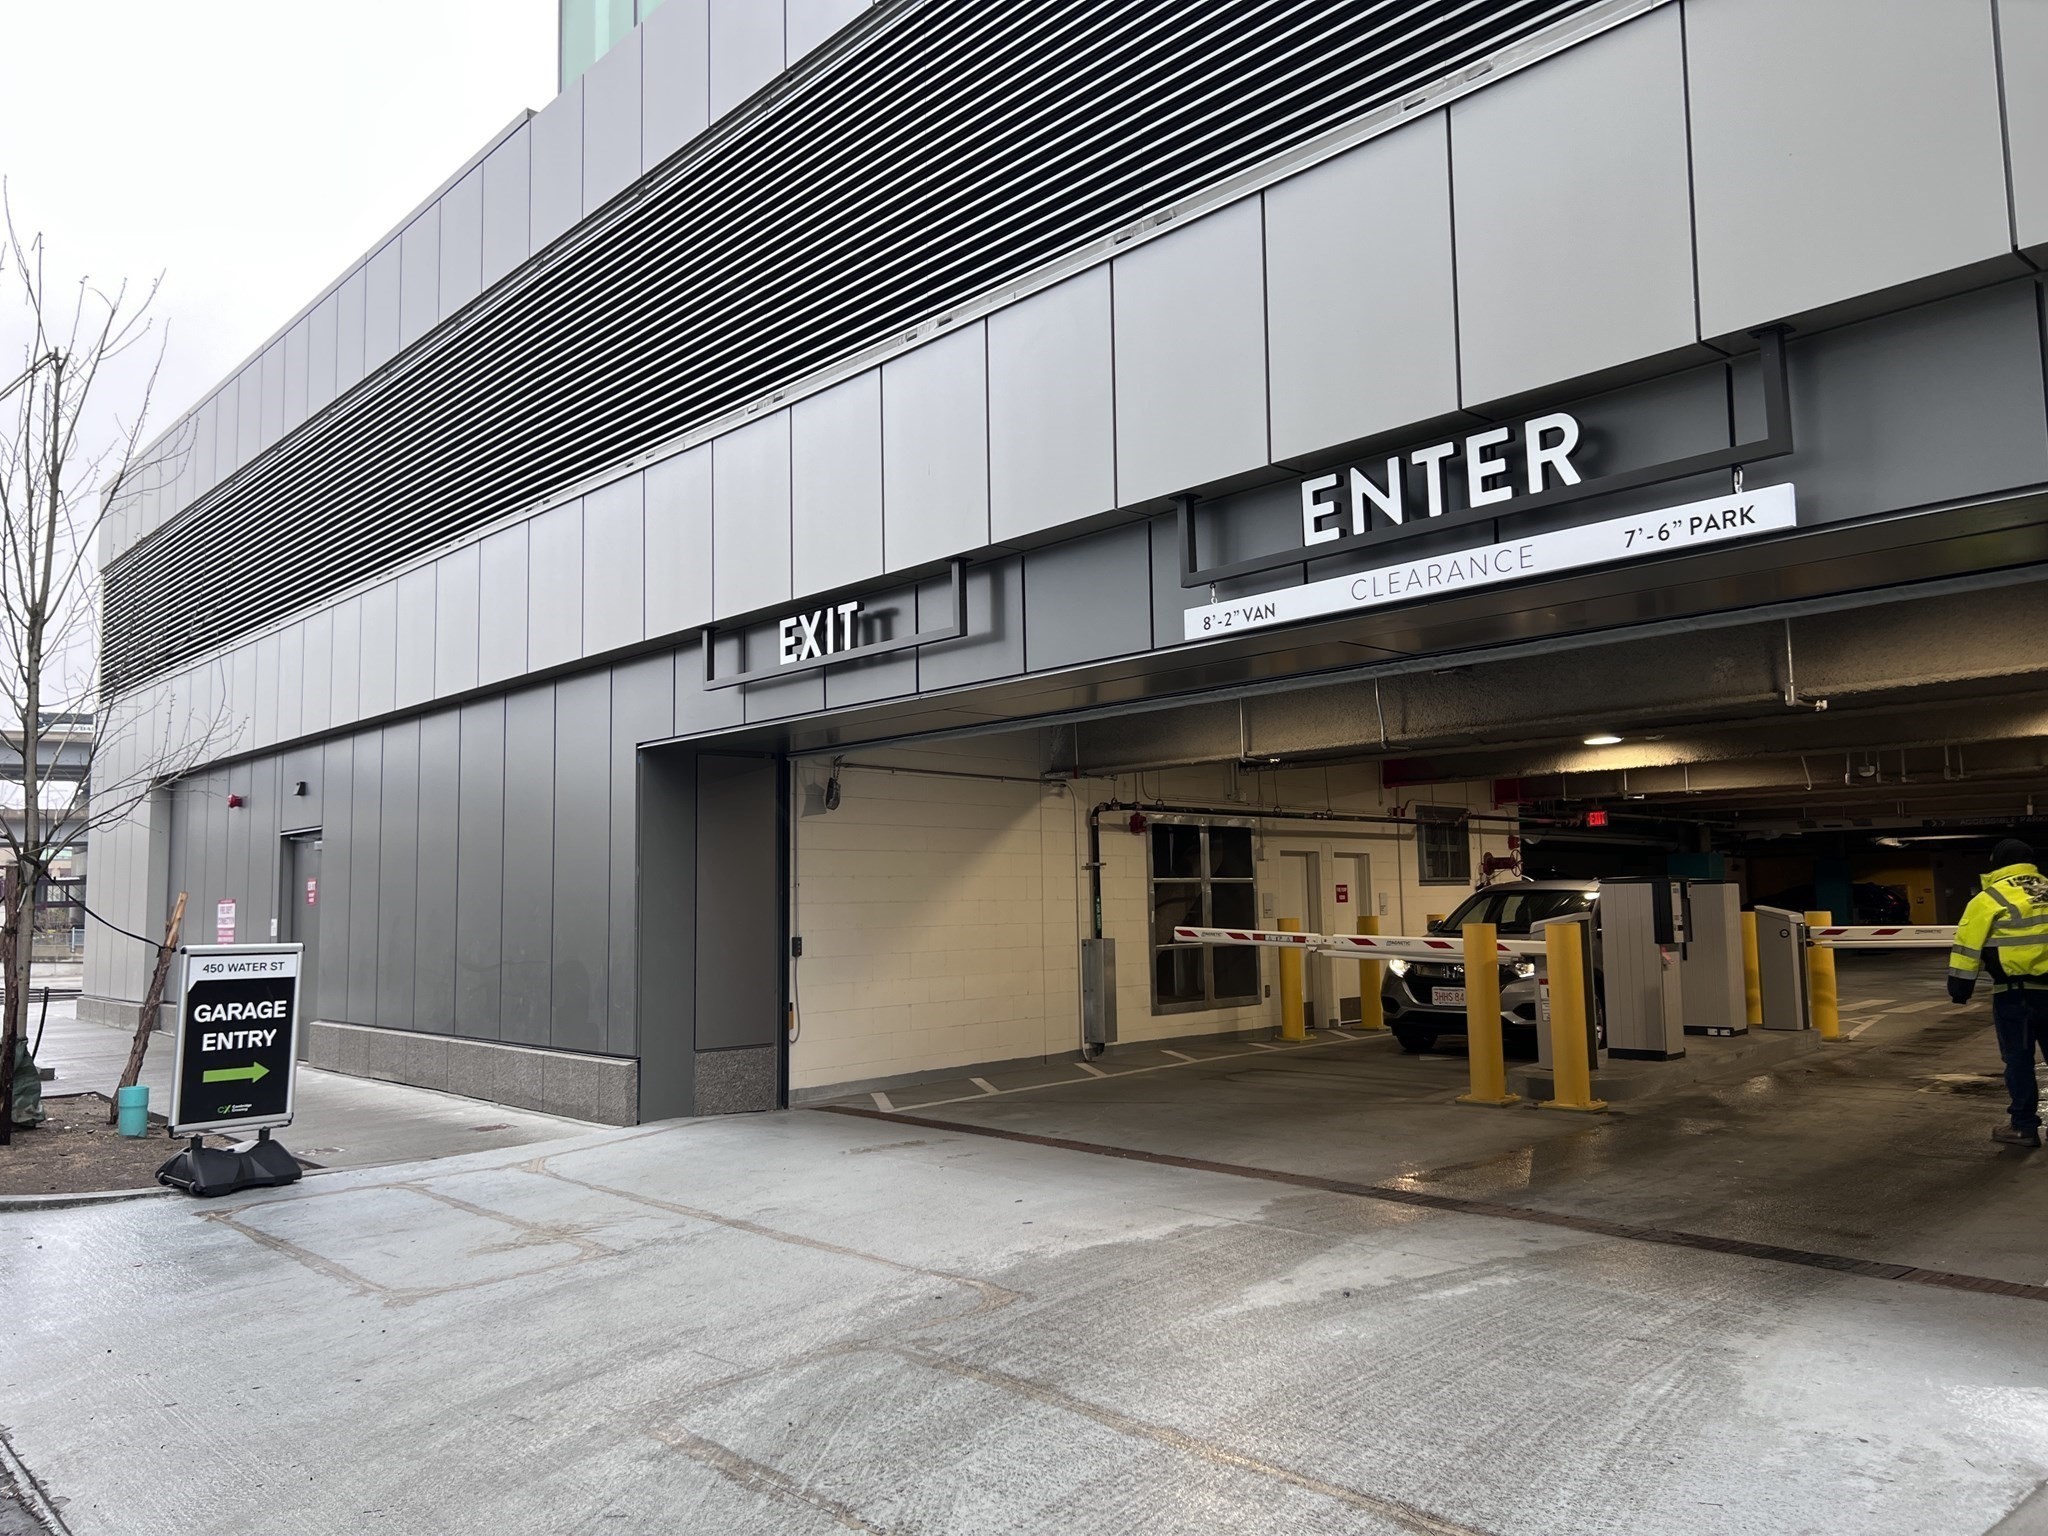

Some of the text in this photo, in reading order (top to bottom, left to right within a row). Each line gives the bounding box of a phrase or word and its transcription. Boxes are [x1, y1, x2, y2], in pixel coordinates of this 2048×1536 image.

[1301, 412, 1582, 547] ENTER
[1689, 504, 1756, 536] PARK
[1351, 544, 1534, 601] CLEARANCE
[1242, 602, 1276, 623] VAN
[779, 601, 858, 666] EXIT
[203, 961, 285, 973] 450 WATER ST
[193, 1000, 287, 1023] GARAGE
[202, 1028, 277, 1052] ENTRY
